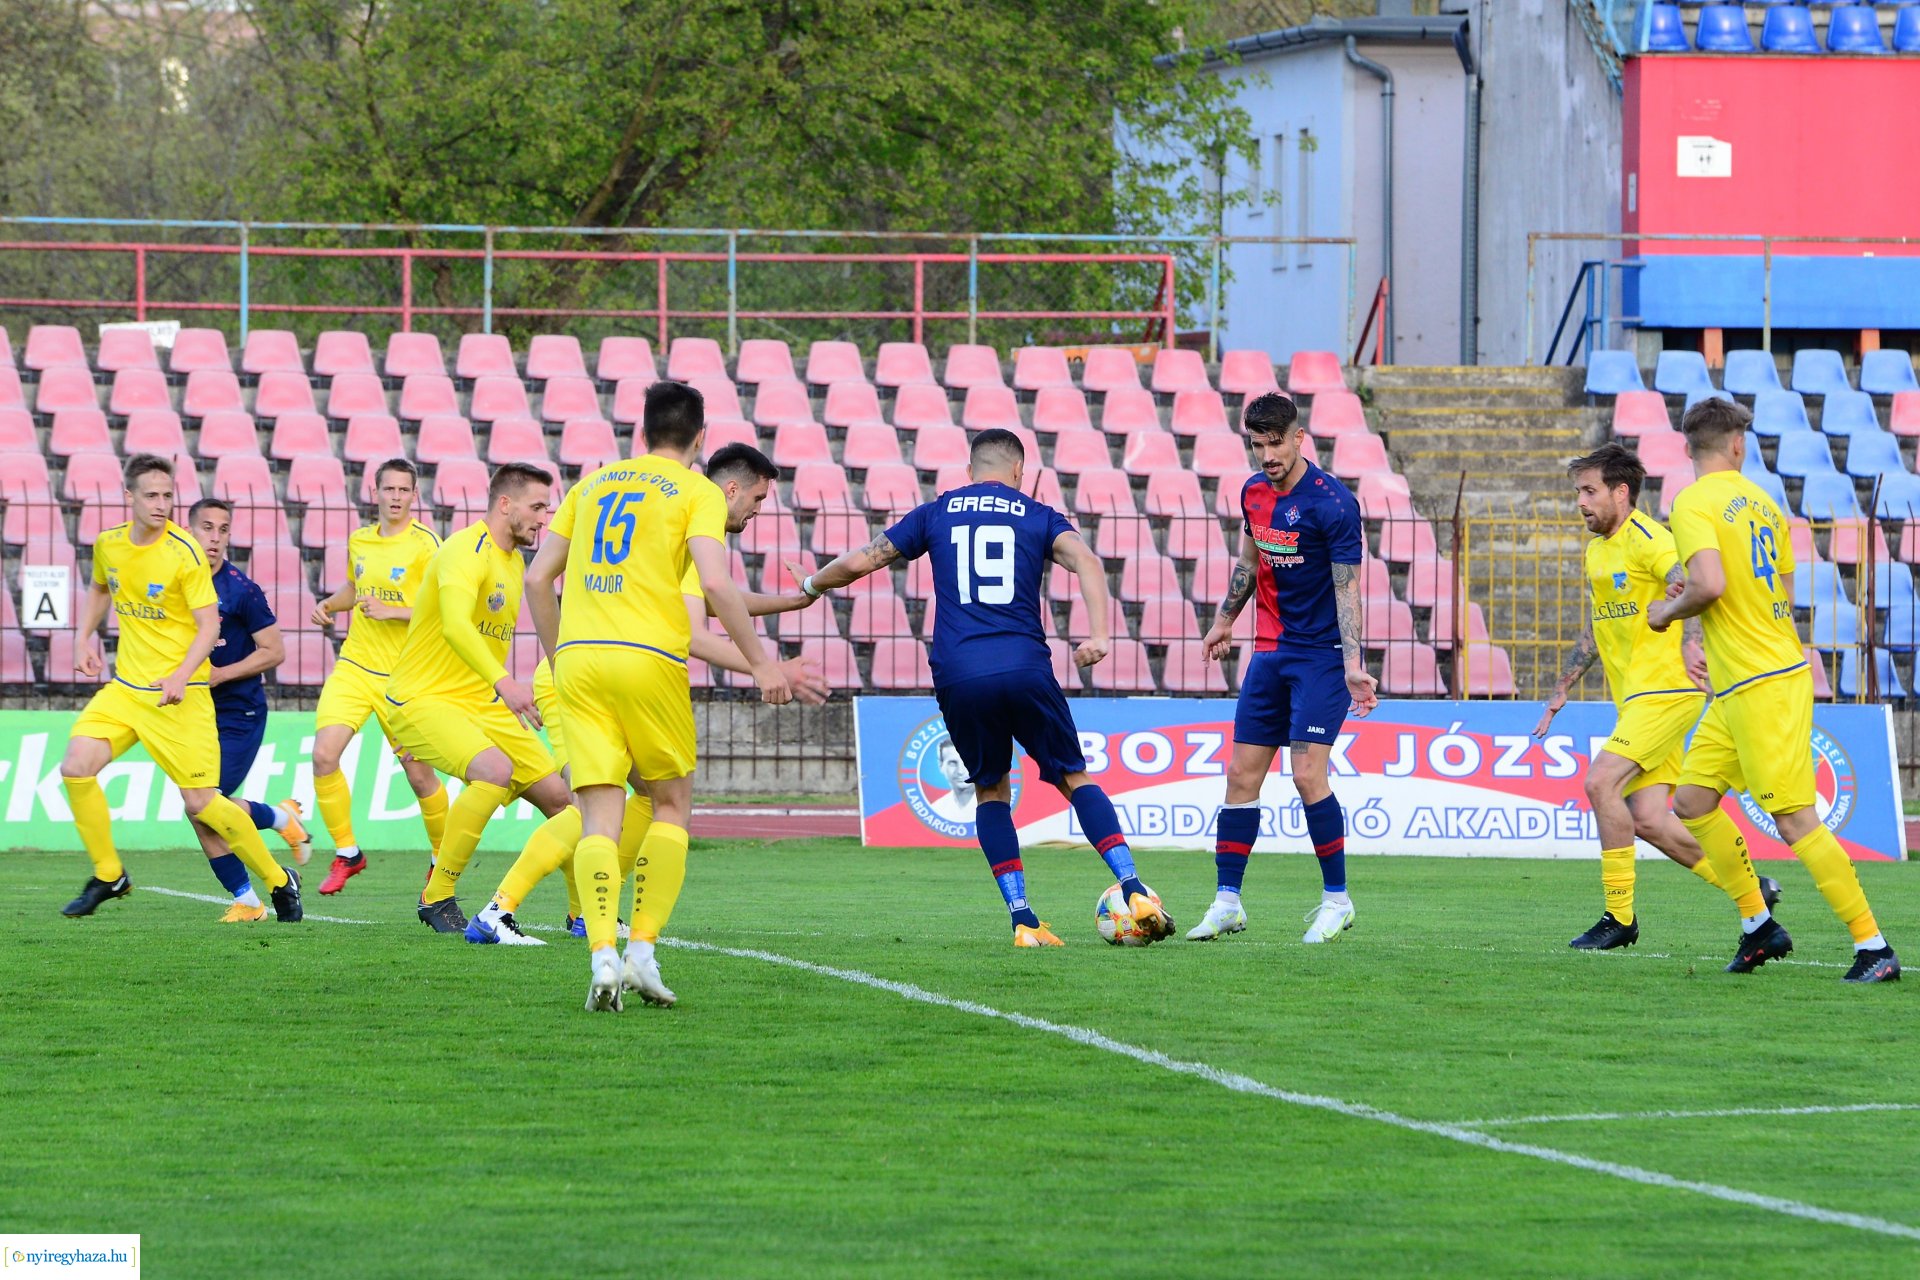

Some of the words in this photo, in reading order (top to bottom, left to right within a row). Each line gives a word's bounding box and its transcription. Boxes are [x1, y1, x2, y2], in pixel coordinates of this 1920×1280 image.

[591, 491, 645, 565] 15
[951, 525, 1016, 605] 19
[584, 574, 623, 593] MAJOR
[34, 592, 58, 621] A
[906, 720, 946, 760] BOZSI
[1307, 725, 1326, 735] JAKO
[1611, 736, 1630, 746] JAKO
[905, 786, 967, 837] LABDARÚGÓ
